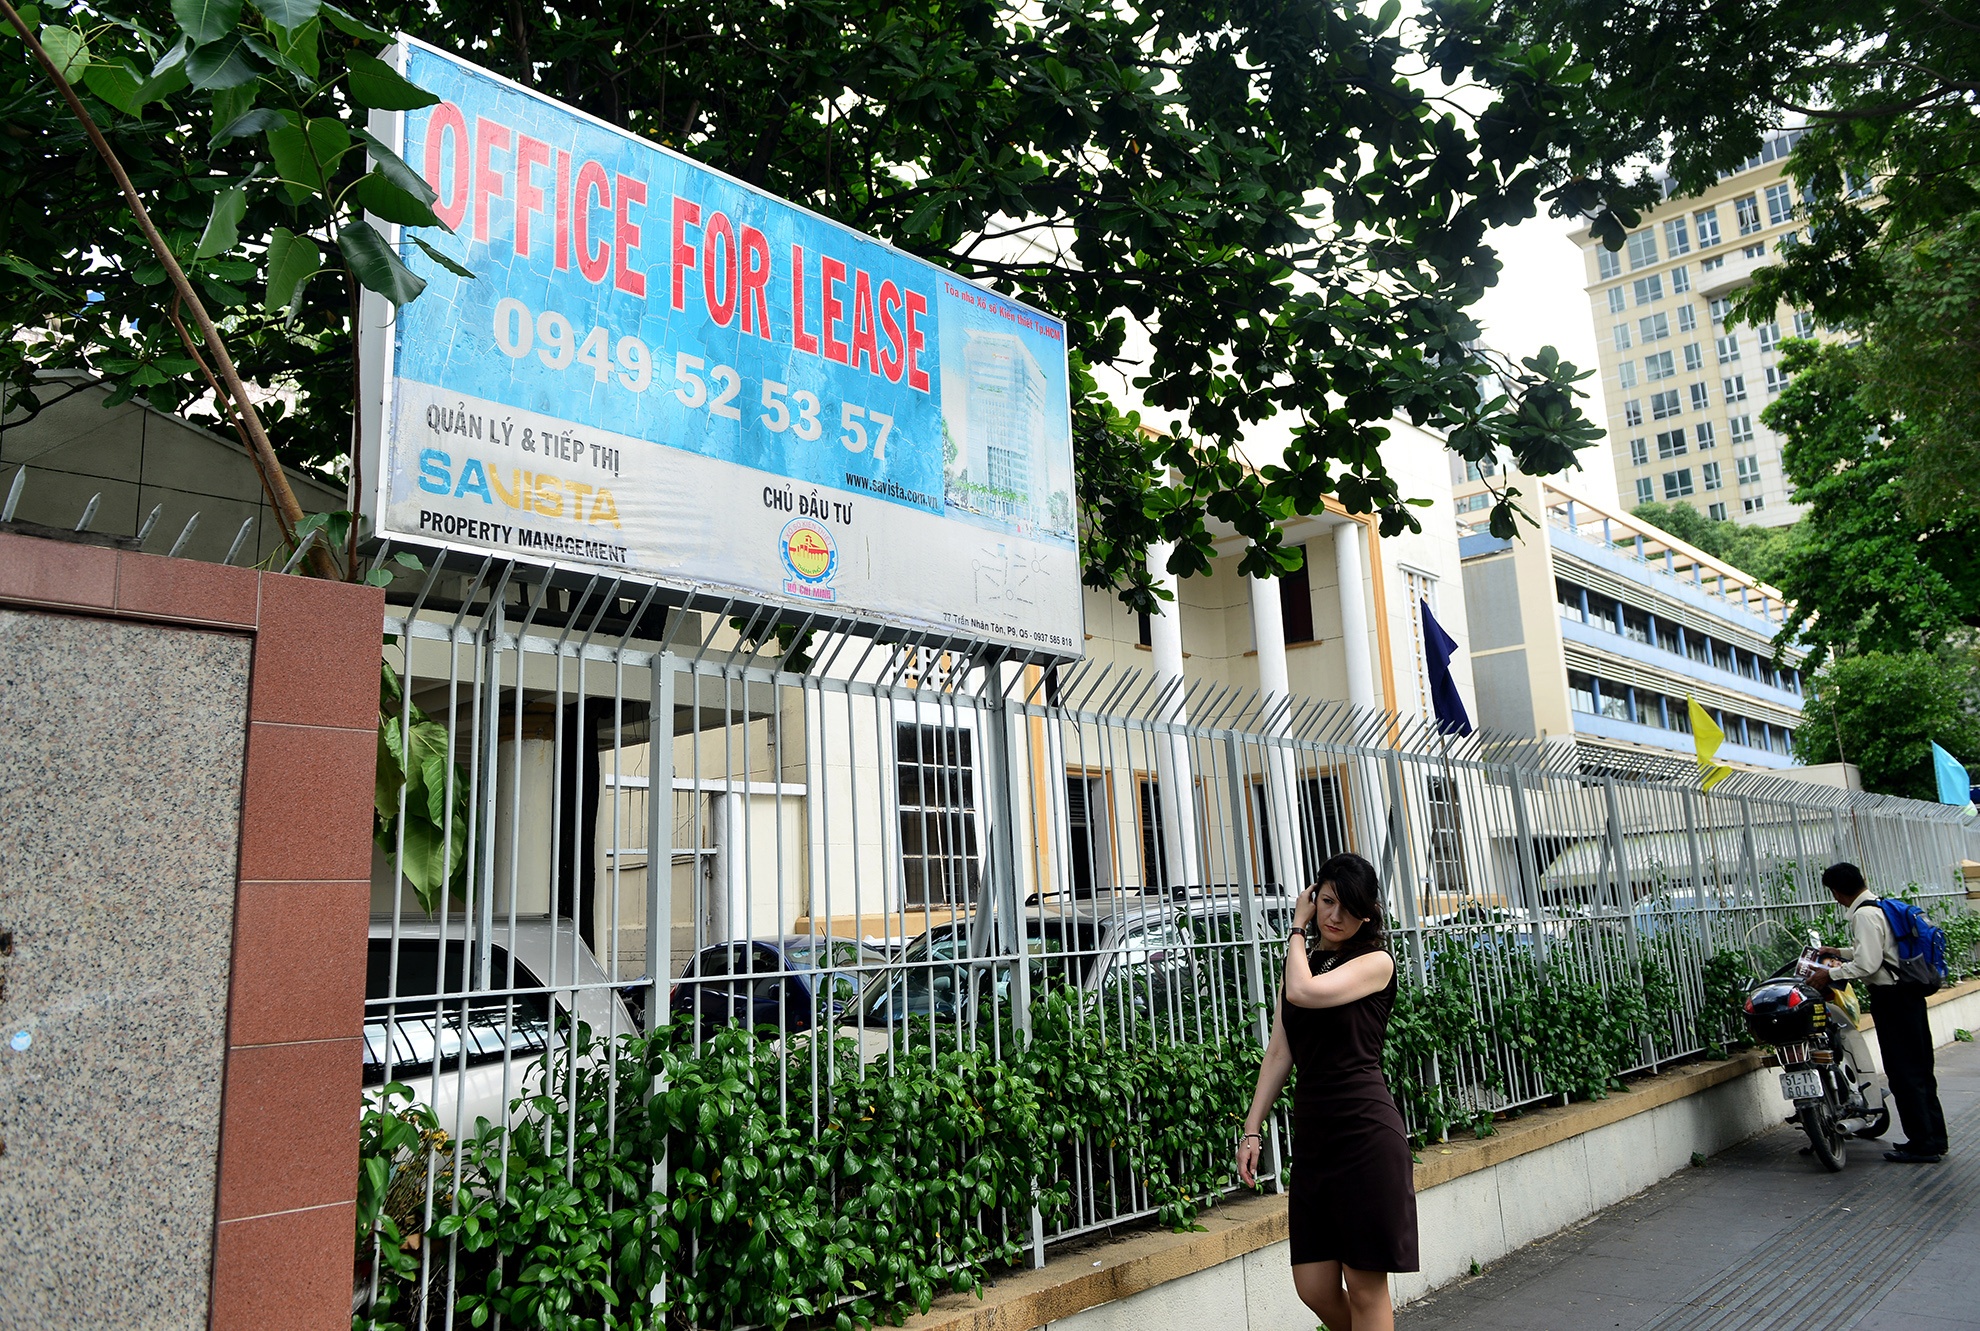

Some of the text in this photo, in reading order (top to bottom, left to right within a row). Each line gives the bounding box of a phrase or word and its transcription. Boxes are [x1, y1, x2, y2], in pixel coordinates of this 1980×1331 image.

[424, 101, 930, 394] OFFICE FOR LEASE
[1035, 321, 1061, 341] Tp.HCM
[493, 299, 894, 460] 0949 52 53 57
[426, 402, 620, 478] QUẢN LÝ & TIẾP THỊ
[417, 447, 622, 530] SAVISTA
[763, 483, 853, 525] CHỦ ĐẦU TƯ
[845, 472, 939, 510] www.savista.com.vn
[420, 510, 628, 564] PROPERTY MANAGEMENT
[943, 612, 951, 622] 77
[971, 618, 989, 631] Nhân
[1020, 628, 1029, 639] Q5
[1034, 631, 1048, 643] 0937
[1049, 636, 1061, 645] 585
[1788, 1084, 1817, 1097] 6048
